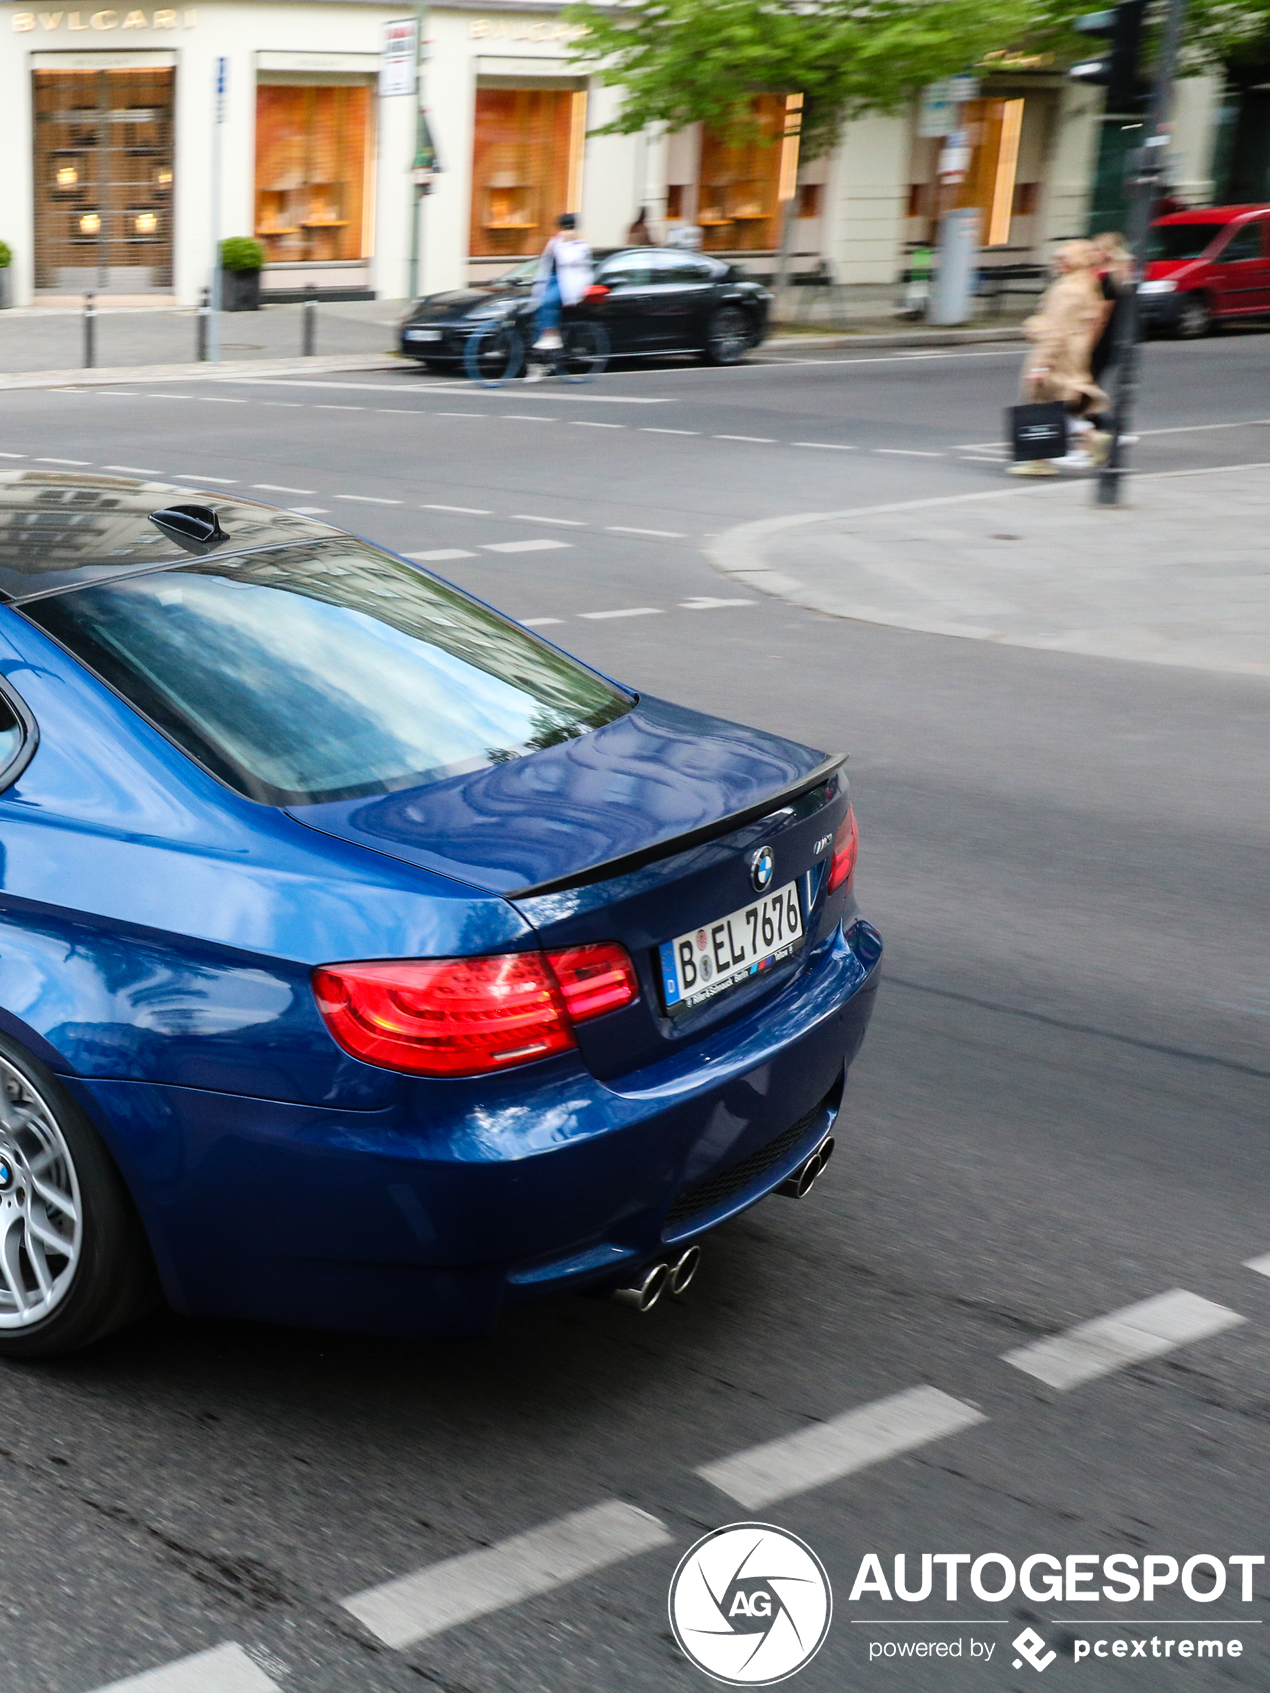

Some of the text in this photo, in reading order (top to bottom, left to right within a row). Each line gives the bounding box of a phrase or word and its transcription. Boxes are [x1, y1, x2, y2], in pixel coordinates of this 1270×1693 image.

[679, 889, 798, 990] B EL 7676
